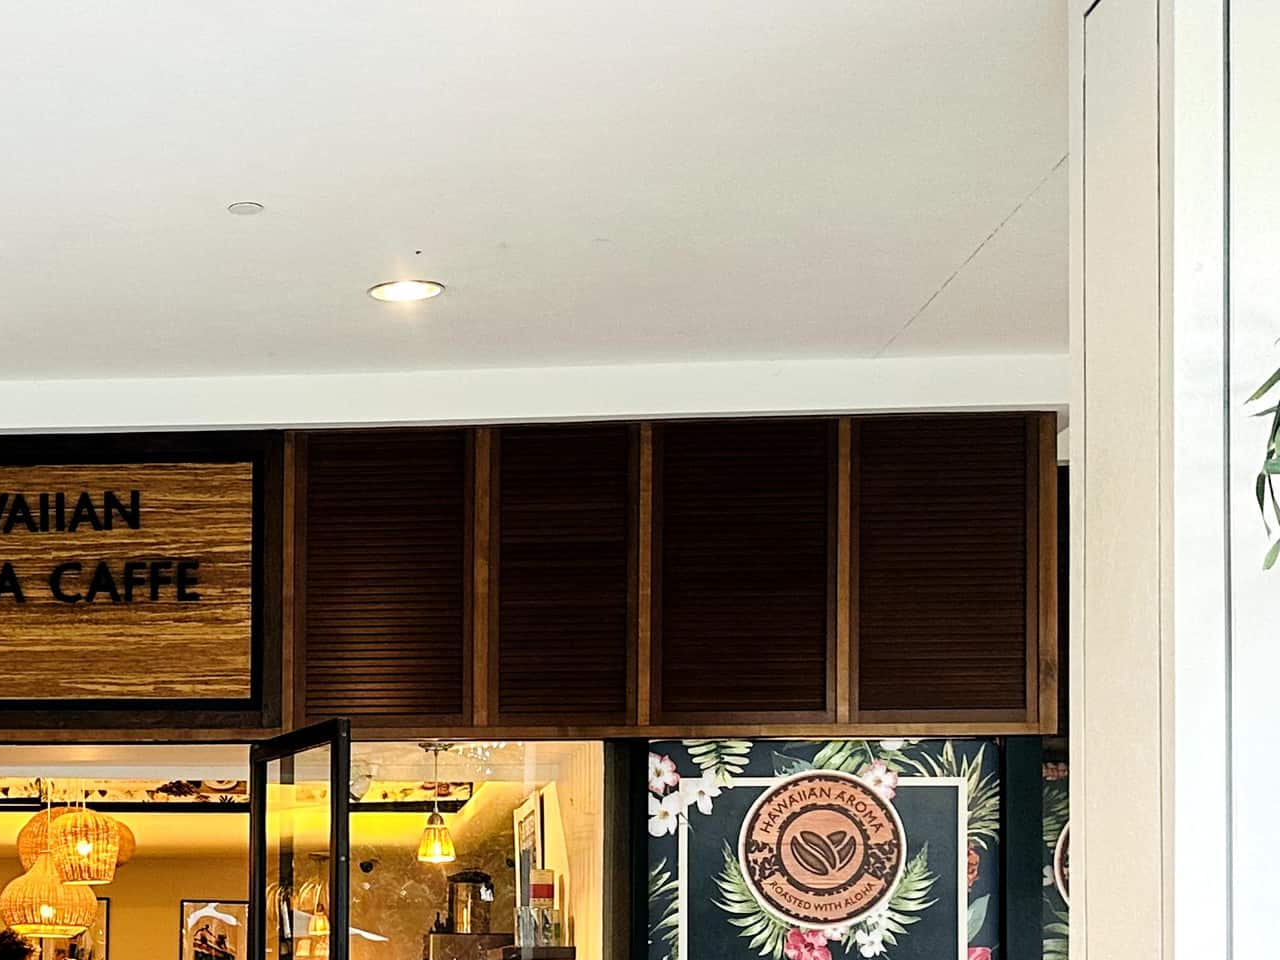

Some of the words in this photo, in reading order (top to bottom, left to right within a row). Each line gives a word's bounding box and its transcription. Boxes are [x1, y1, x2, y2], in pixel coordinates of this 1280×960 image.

[49, 559, 201, 603] CAFFE
[759, 787, 832, 835] HAWAIIAN
[835, 790, 885, 834] AROMA
[767, 880, 812, 912] ROASTED
[813, 901, 843, 912] WITH
[844, 881, 877, 909] ALOHA
